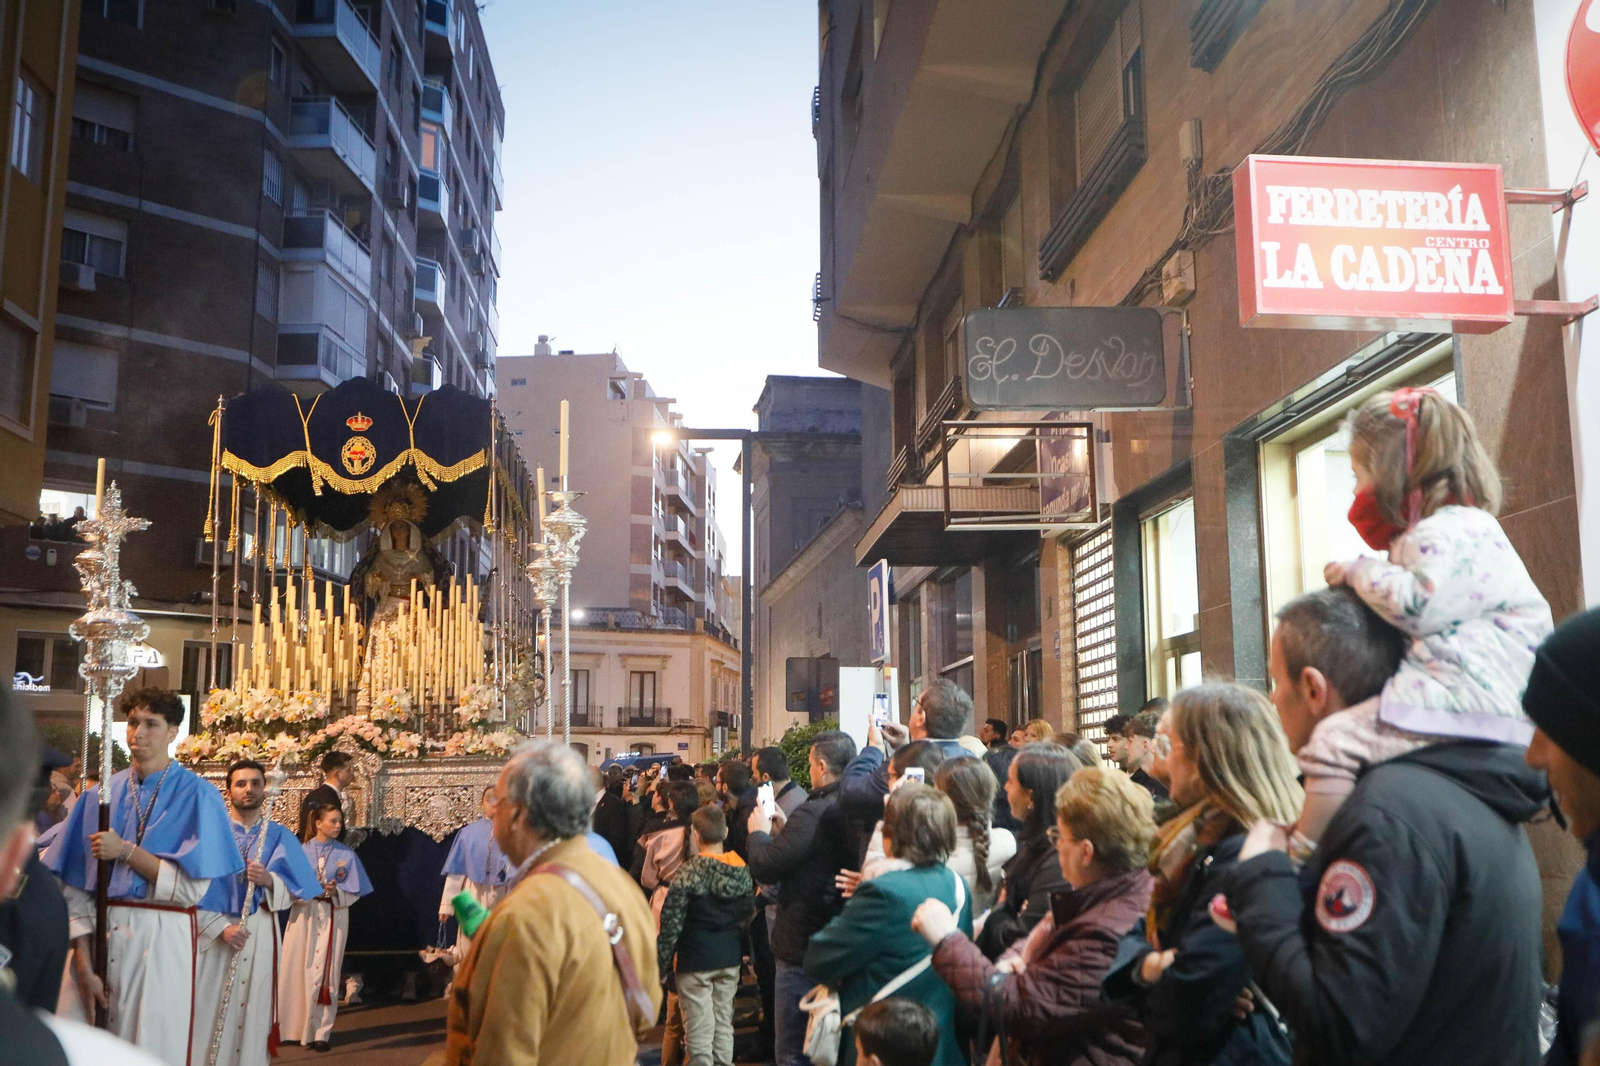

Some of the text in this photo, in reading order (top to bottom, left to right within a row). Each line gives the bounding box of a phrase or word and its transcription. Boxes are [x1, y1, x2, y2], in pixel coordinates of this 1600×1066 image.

[1266, 184, 1490, 231] FERRETERÍA
[1261, 241, 1503, 294] LA CADENA
[1425, 236, 1490, 249] CENTRO
[870, 576, 880, 650] P
